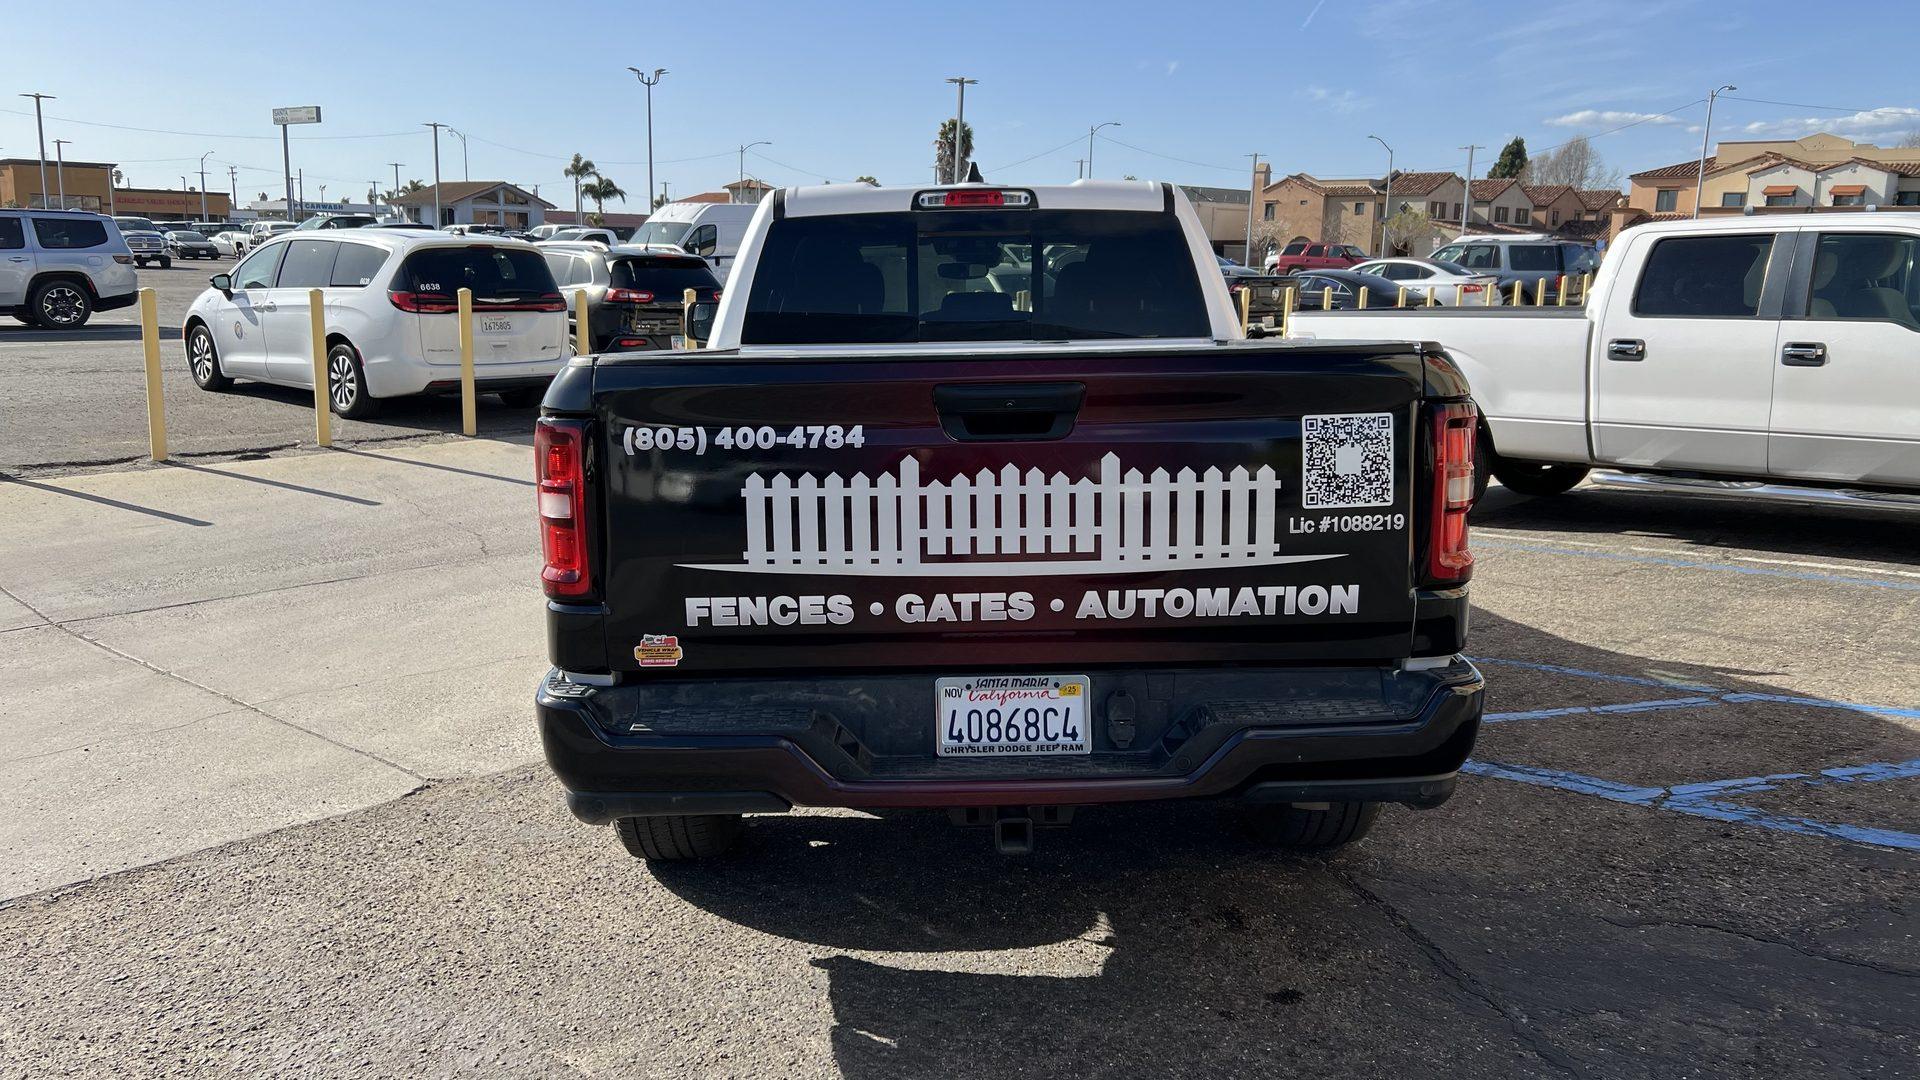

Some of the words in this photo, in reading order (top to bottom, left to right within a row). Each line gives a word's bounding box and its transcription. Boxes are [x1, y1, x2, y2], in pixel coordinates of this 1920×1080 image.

[420, 283, 441, 291] 6638
[623, 426, 707, 456] (805)
[714, 425, 866, 450] 400-4784
[1289, 516, 1315, 534] Lic
[1319, 513, 1405, 533] #1088219
[684, 594, 855, 627] FENCES
[895, 591, 1036, 624] GATES
[1075, 584, 1361, 619] AUTOMATION
[975, 678, 1009, 690] SANTA
[1010, 677, 1049, 688] MARIA
[944, 688, 963, 699] NOV
[968, 689, 1060, 706] California
[948, 707, 1079, 744] 40868C4
[944, 745, 995, 754] CHRYSLER
[998, 744, 1032, 753] DODGE
[1035, 744, 1059, 752] JEEP
[1061, 744, 1084, 752] RAM
